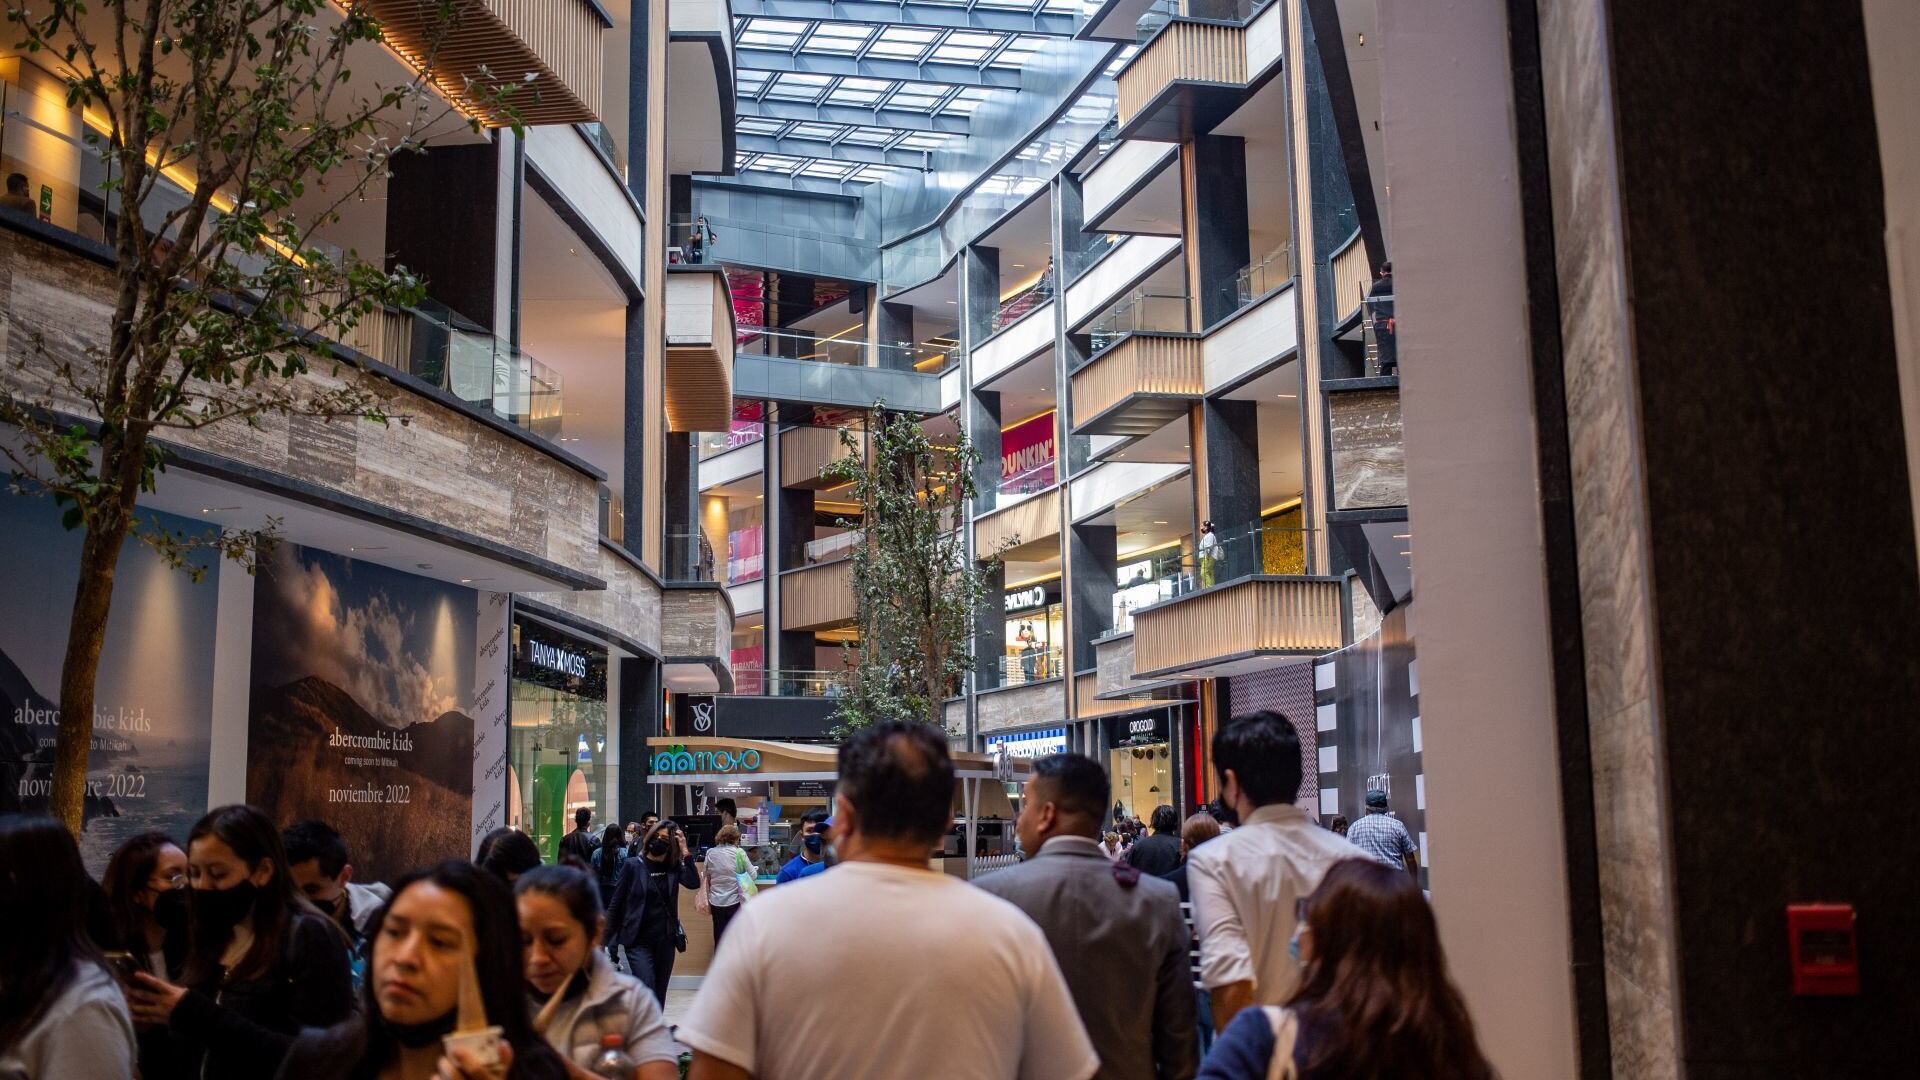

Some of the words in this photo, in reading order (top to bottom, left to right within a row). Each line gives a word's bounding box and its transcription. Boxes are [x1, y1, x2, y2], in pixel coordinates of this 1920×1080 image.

[530, 640, 556, 669] TANYA
[564, 652, 586, 678] MOSS
[14, 699, 115, 730] abercbie
[118, 706, 151, 732] kids
[329, 726, 390, 750] abercrombie
[392, 731, 413, 752] kids
[344, 756, 363, 768] coming
[363, 759, 375, 767] soon
[18, 773, 103, 798] novire
[106, 774, 146, 798] 2022
[329, 781, 384, 803] noviembre
[385, 784, 410, 804] 2022
